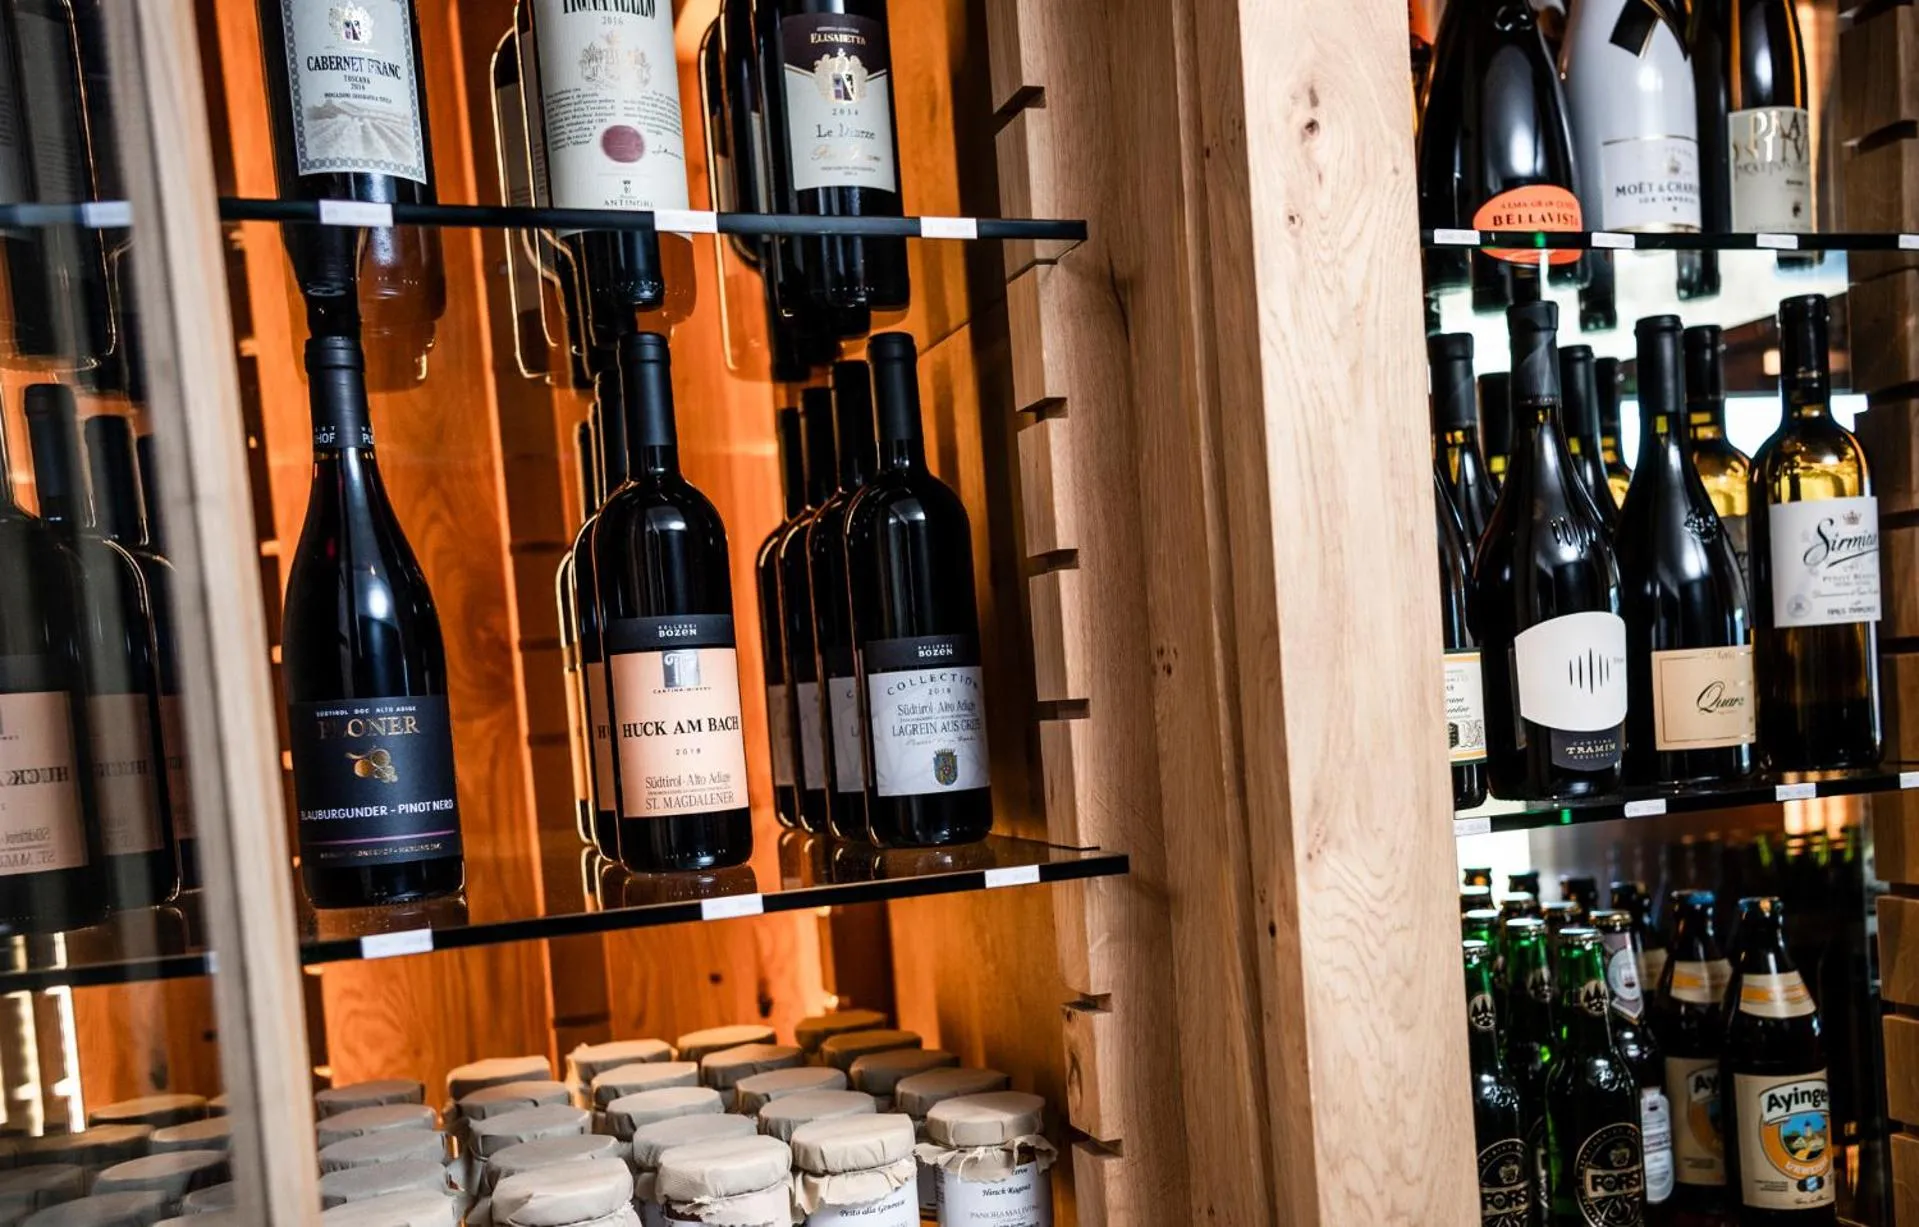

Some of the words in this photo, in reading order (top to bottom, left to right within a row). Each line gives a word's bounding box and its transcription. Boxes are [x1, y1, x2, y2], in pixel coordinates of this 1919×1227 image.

[306, 55, 365, 73] CABERNET
[367, 58, 402, 80] FRANC
[816, 124, 834, 138] Le
[1492, 212, 1579, 226] BELLAVISTA
[1696, 681, 1745, 713] Quarz
[623, 721, 667, 738] HUCK
[674, 719, 702, 735] AM
[707, 715, 739, 732] BACH
[892, 722, 938, 737] LAGREIN
[941, 720, 959, 733] AUS
[1565, 743, 1617, 755] TRAMIN
[645, 775, 682, 789] Südtirol
[398, 801, 431, 815] PINOT
[432, 799, 454, 811] NERO
[663, 790, 735, 809] MAGDALENER
